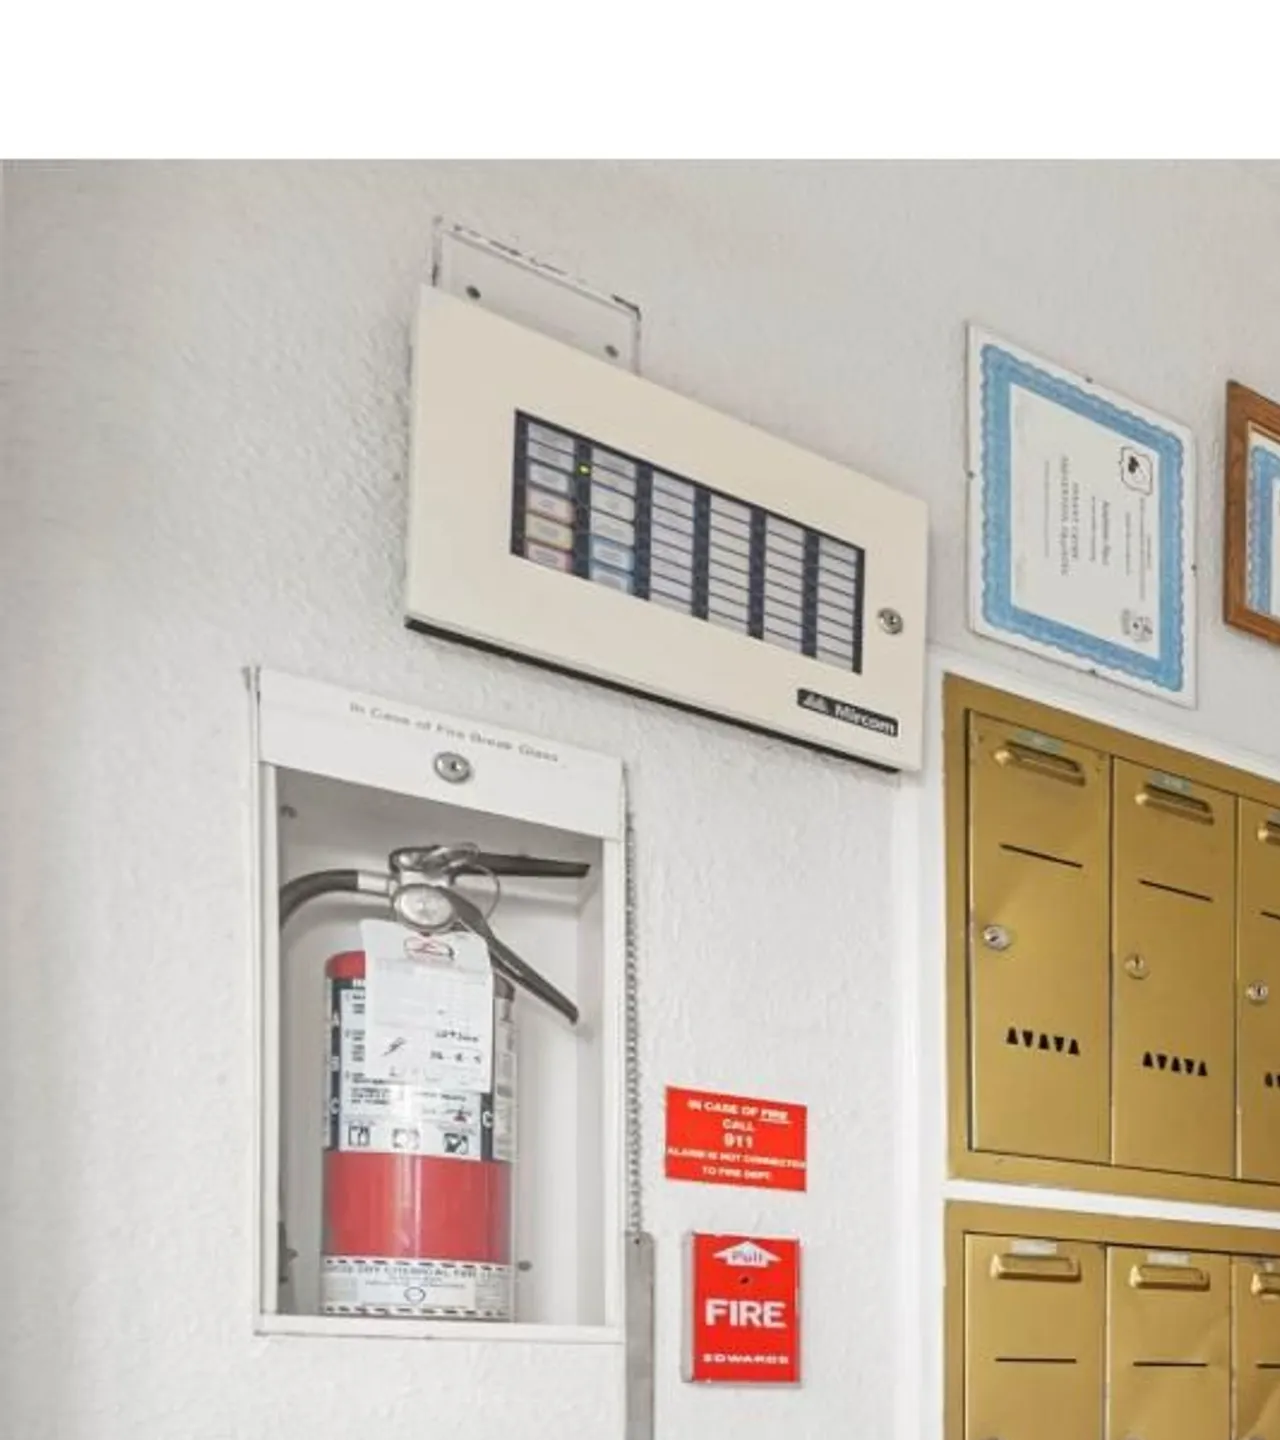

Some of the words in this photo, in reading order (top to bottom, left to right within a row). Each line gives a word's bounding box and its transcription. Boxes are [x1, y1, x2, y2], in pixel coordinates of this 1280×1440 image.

[704, 1101, 738, 1115] CASE
[741, 1105, 759, 1117] OF
[722, 1118, 755, 1132] CALL
[723, 1133, 753, 1149] 911
[702, 1166, 717, 1176] TO
[731, 1251, 763, 1263] Pull
[705, 1297, 787, 1329] FIRE
